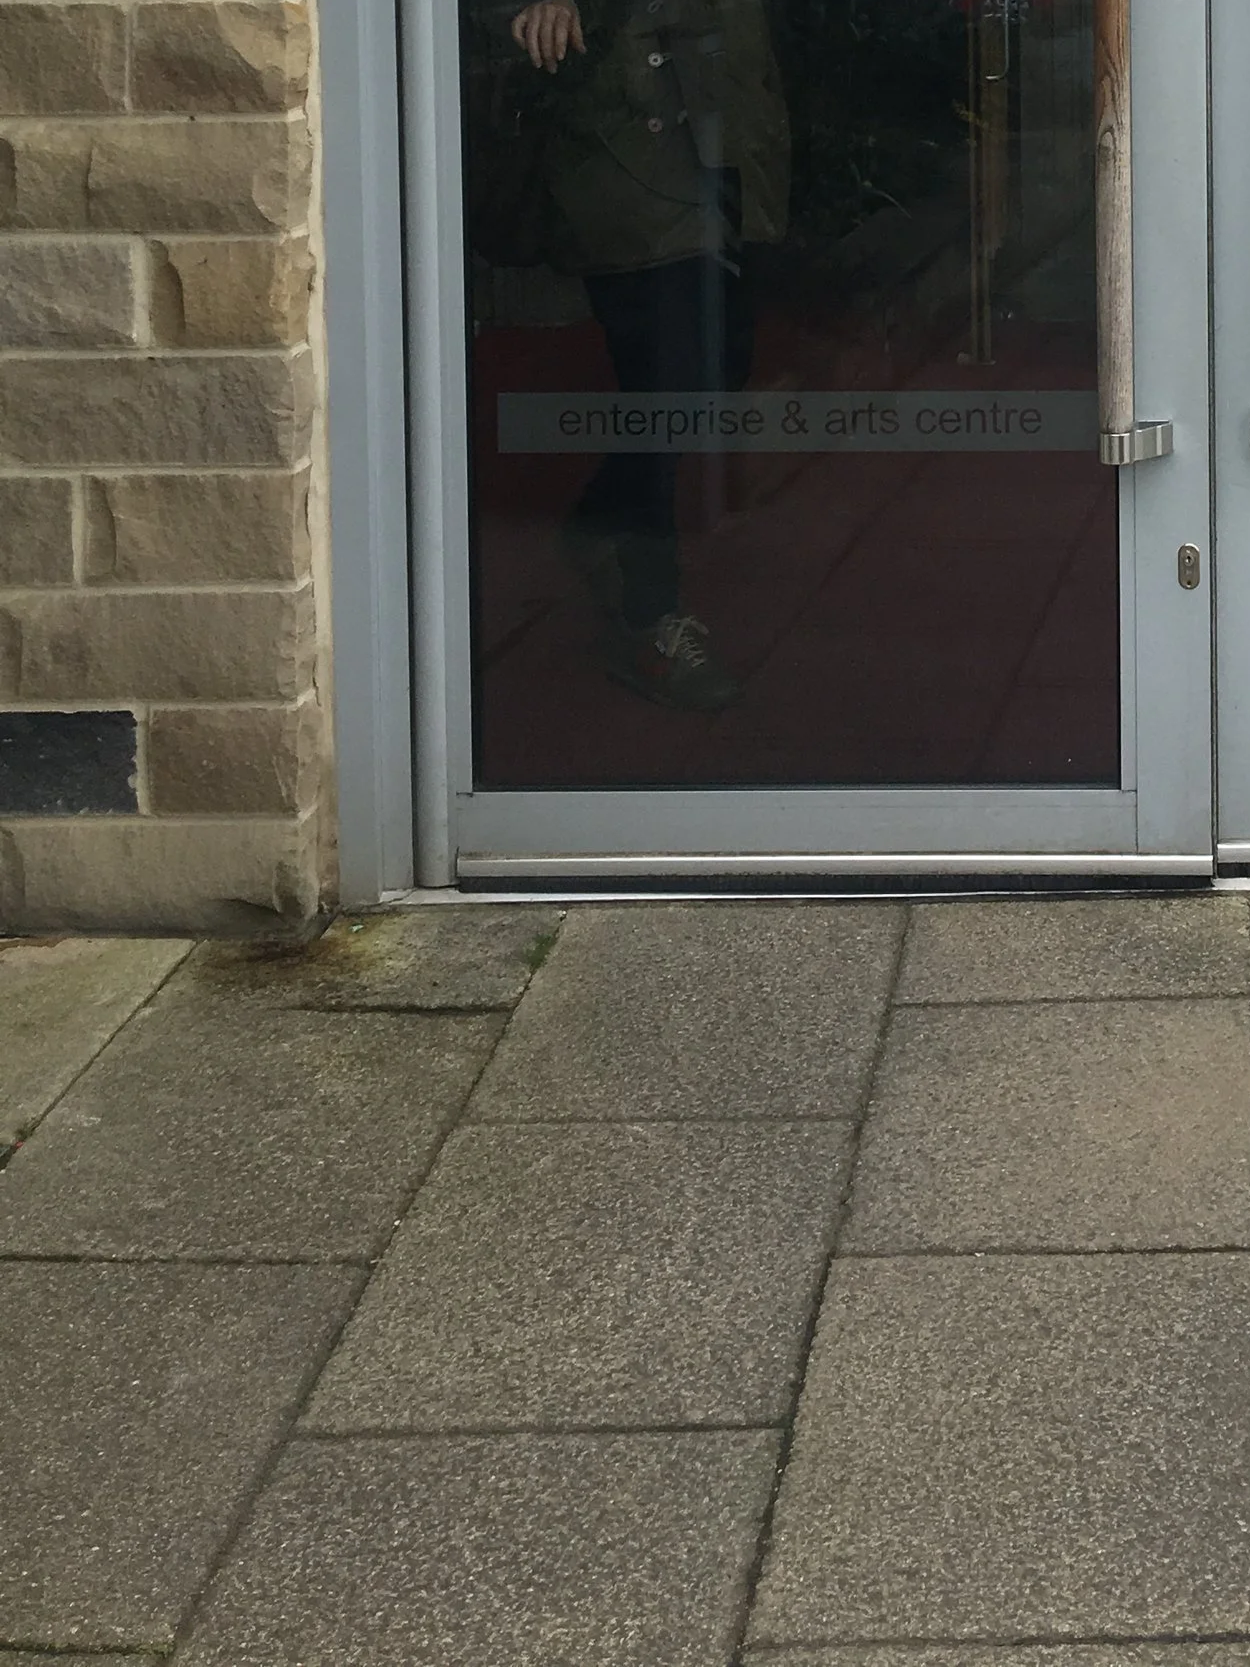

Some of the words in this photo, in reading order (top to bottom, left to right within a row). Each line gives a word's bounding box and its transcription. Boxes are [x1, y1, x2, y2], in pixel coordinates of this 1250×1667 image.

[558, 401, 765, 444] enterprise
[780, 400, 810, 435] &
[824, 401, 900, 435] arts
[914, 401, 1044, 435] centre
